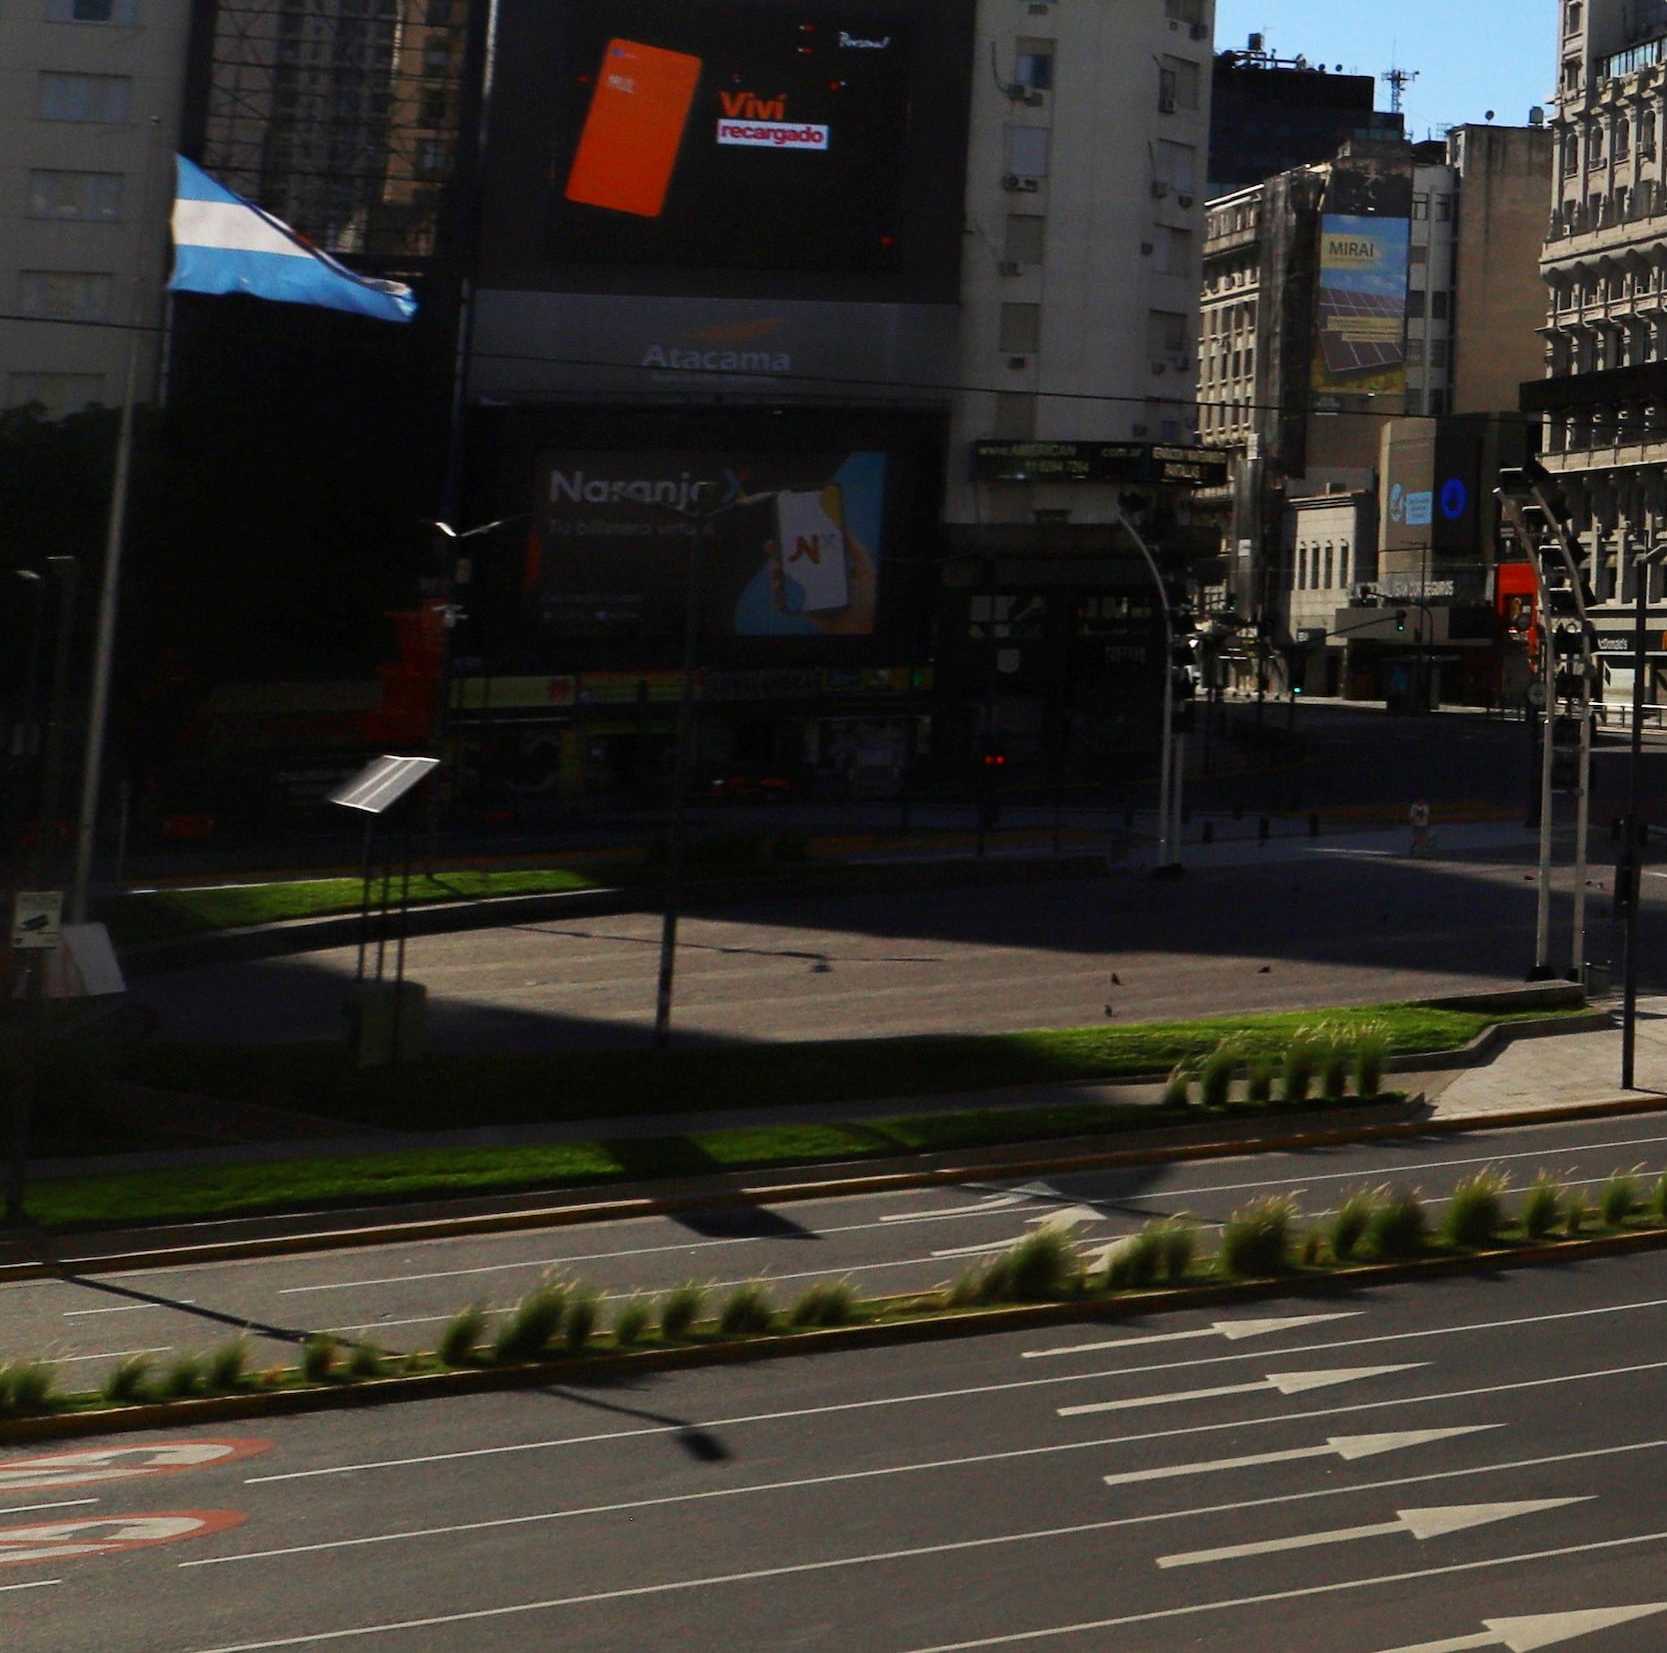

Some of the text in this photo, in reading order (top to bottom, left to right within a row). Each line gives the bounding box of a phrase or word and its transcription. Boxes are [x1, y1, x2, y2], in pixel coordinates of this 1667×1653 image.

[718, 90, 787, 121] Viví
[721, 125, 824, 144] recargado
[1328, 241, 1374, 258] MIRAI
[642, 345, 791, 371] Atacama
